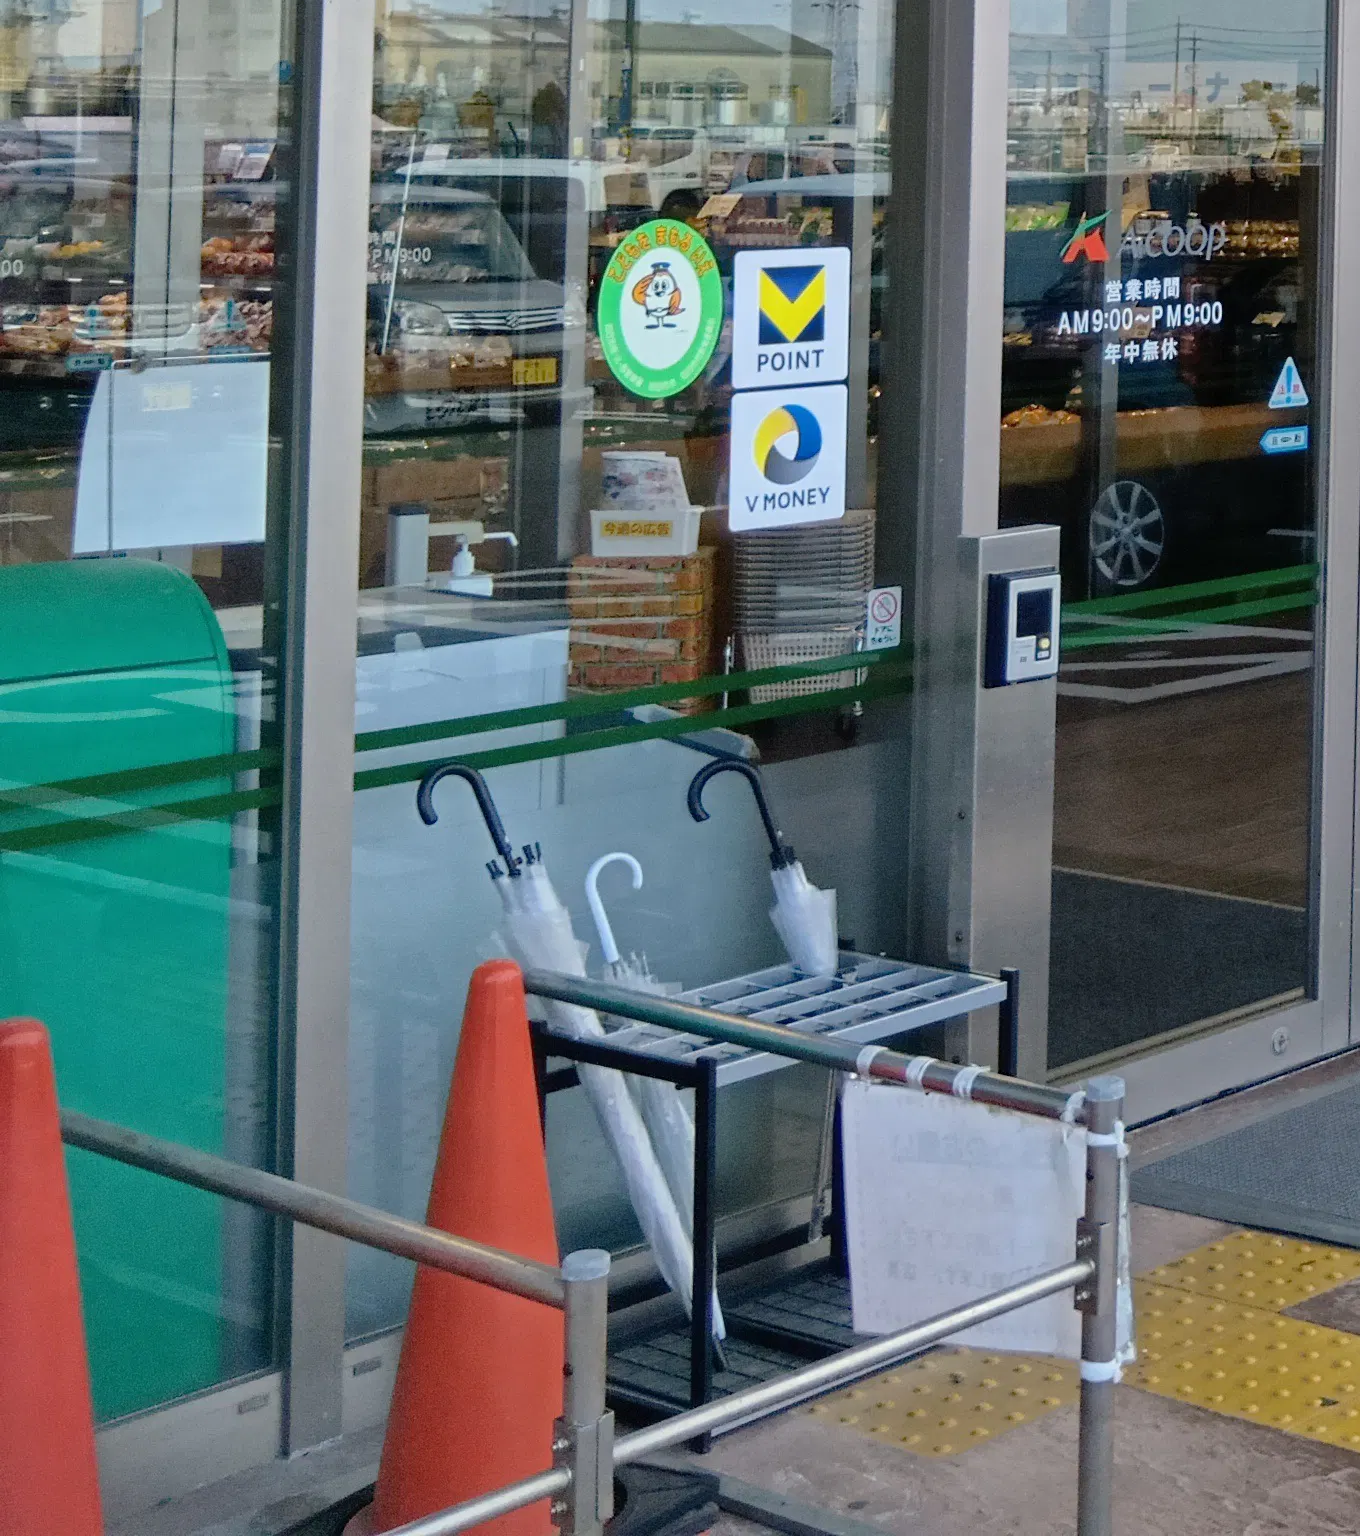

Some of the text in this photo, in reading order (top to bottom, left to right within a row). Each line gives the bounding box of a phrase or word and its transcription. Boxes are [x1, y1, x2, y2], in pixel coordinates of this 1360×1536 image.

[1105, 276, 1181, 303] 営業時間
[757, 349, 825, 373] POINT
[1104, 337, 1179, 365] 年中無休
[745, 485, 832, 513] V MONEY
[603, 521, 670, 536] 今週の広告
